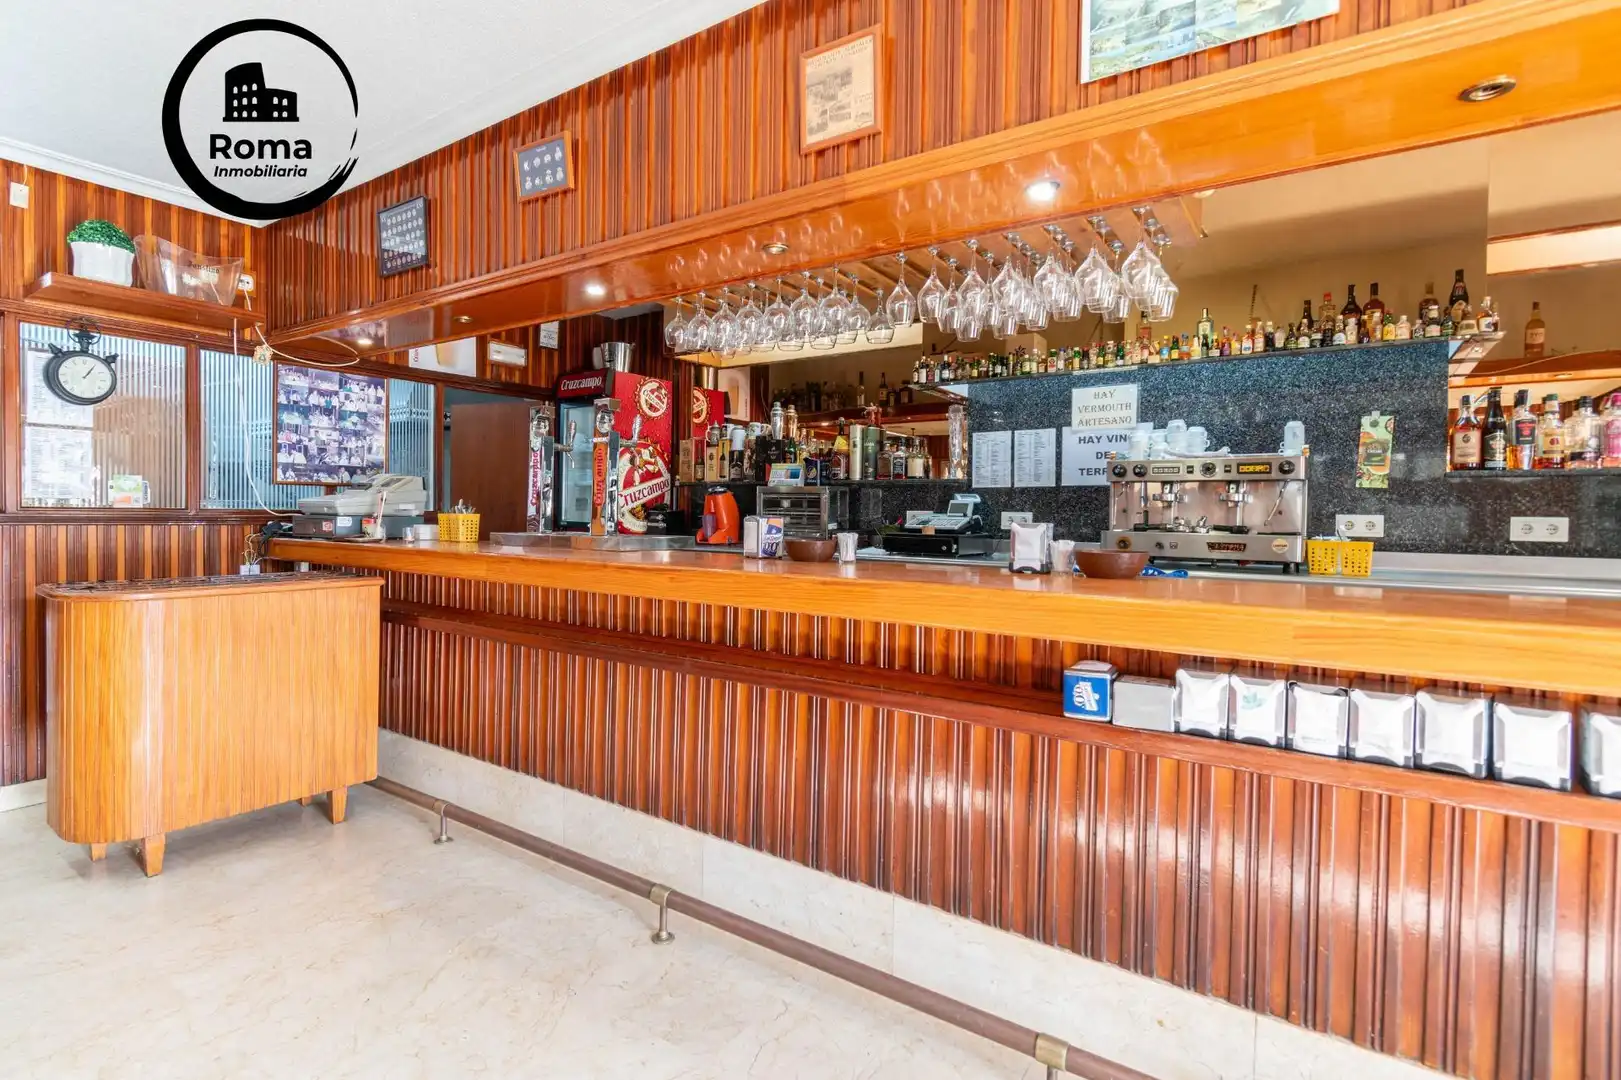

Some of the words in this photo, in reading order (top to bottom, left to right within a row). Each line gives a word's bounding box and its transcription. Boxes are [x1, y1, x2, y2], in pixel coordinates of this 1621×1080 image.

[560, 376, 602, 391] Cruzcampo
[1093, 388, 1117, 400] HAY
[1077, 402, 1132, 414] VERMOUTH
[1078, 435, 1102, 445] HAY
